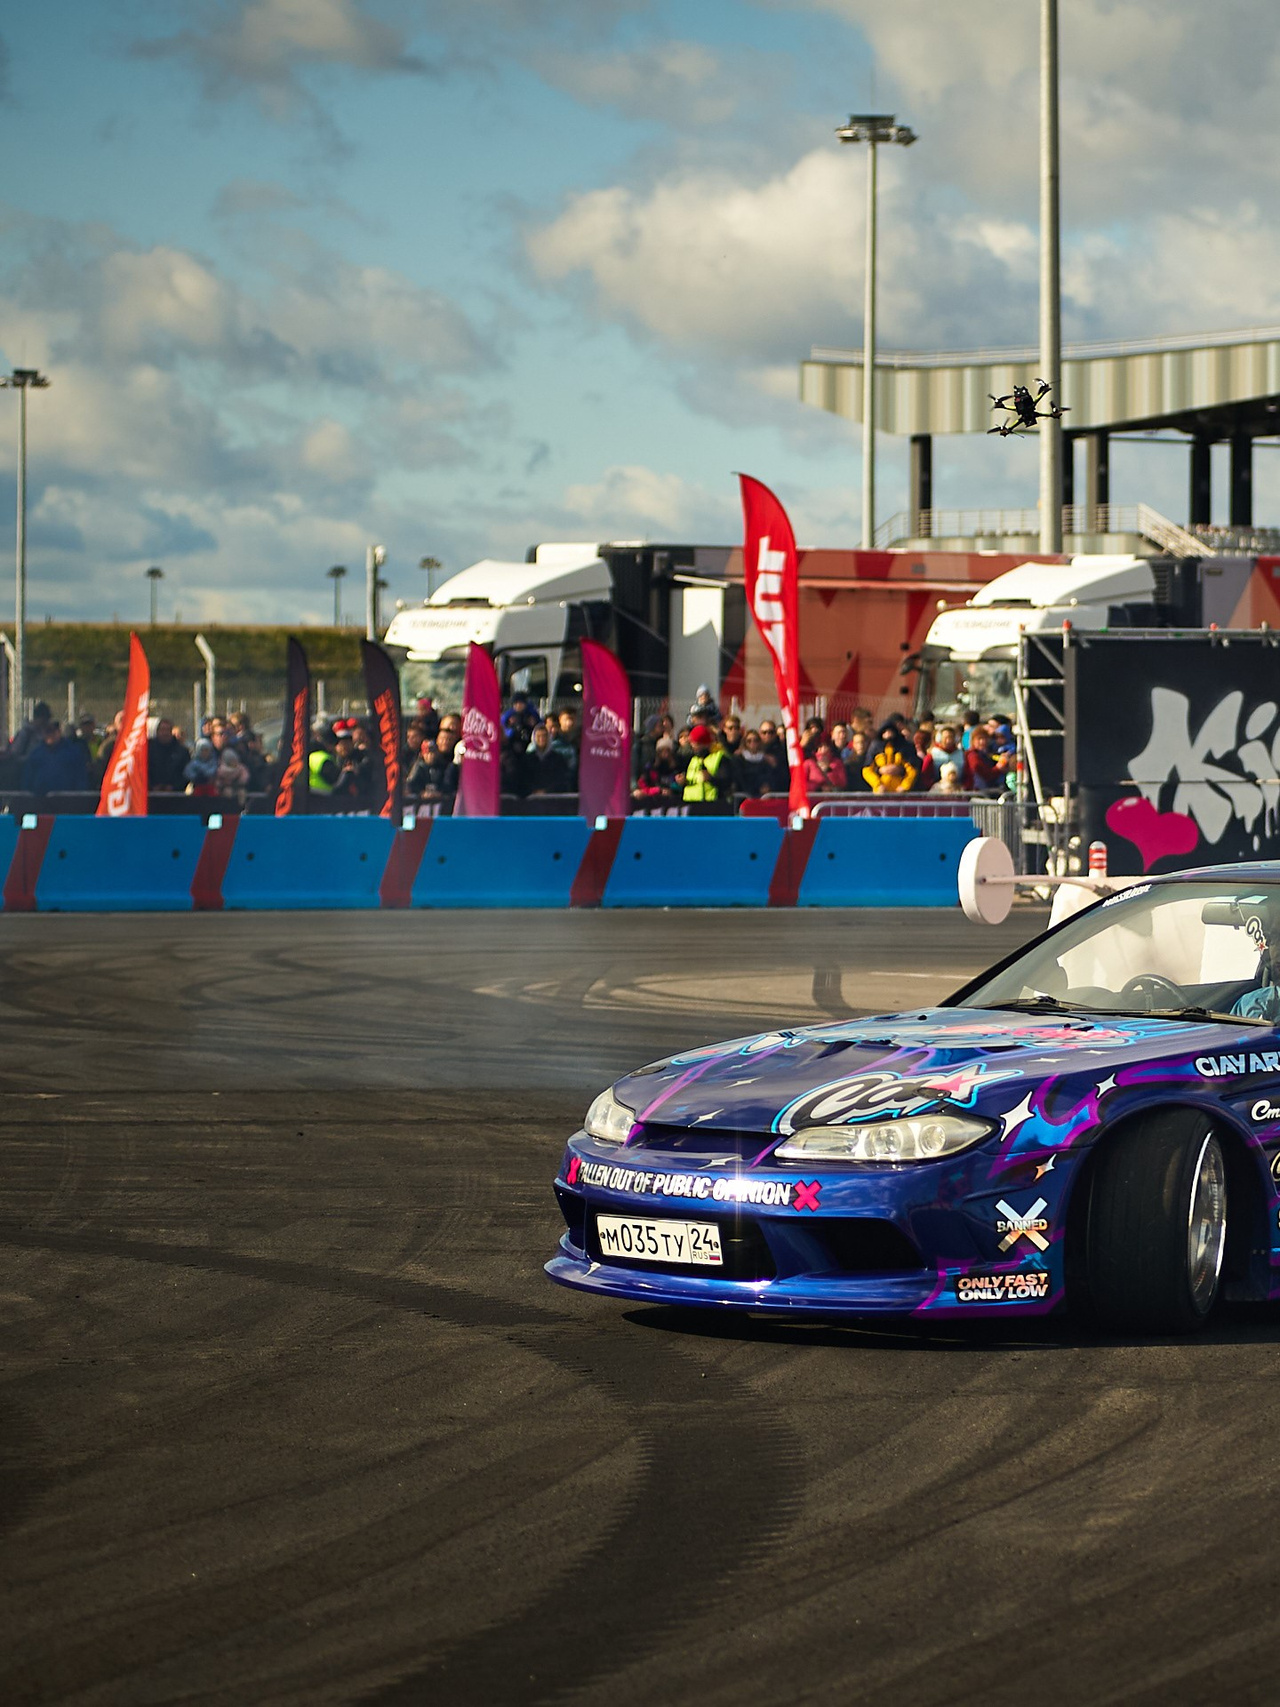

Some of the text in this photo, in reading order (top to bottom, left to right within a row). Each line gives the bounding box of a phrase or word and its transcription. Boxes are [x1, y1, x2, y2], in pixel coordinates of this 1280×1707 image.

[579, 1161, 791, 1206] FALLEN OUT OF PUBLIC OPINION
[996, 1219, 1049, 1233] BANNED
[691, 1228, 713, 1251] 24
[692, 1251, 708, 1260] RUS
[958, 1273, 1048, 1290] ONLY FAST
[959, 1284, 1049, 1301] ONLY LOW
